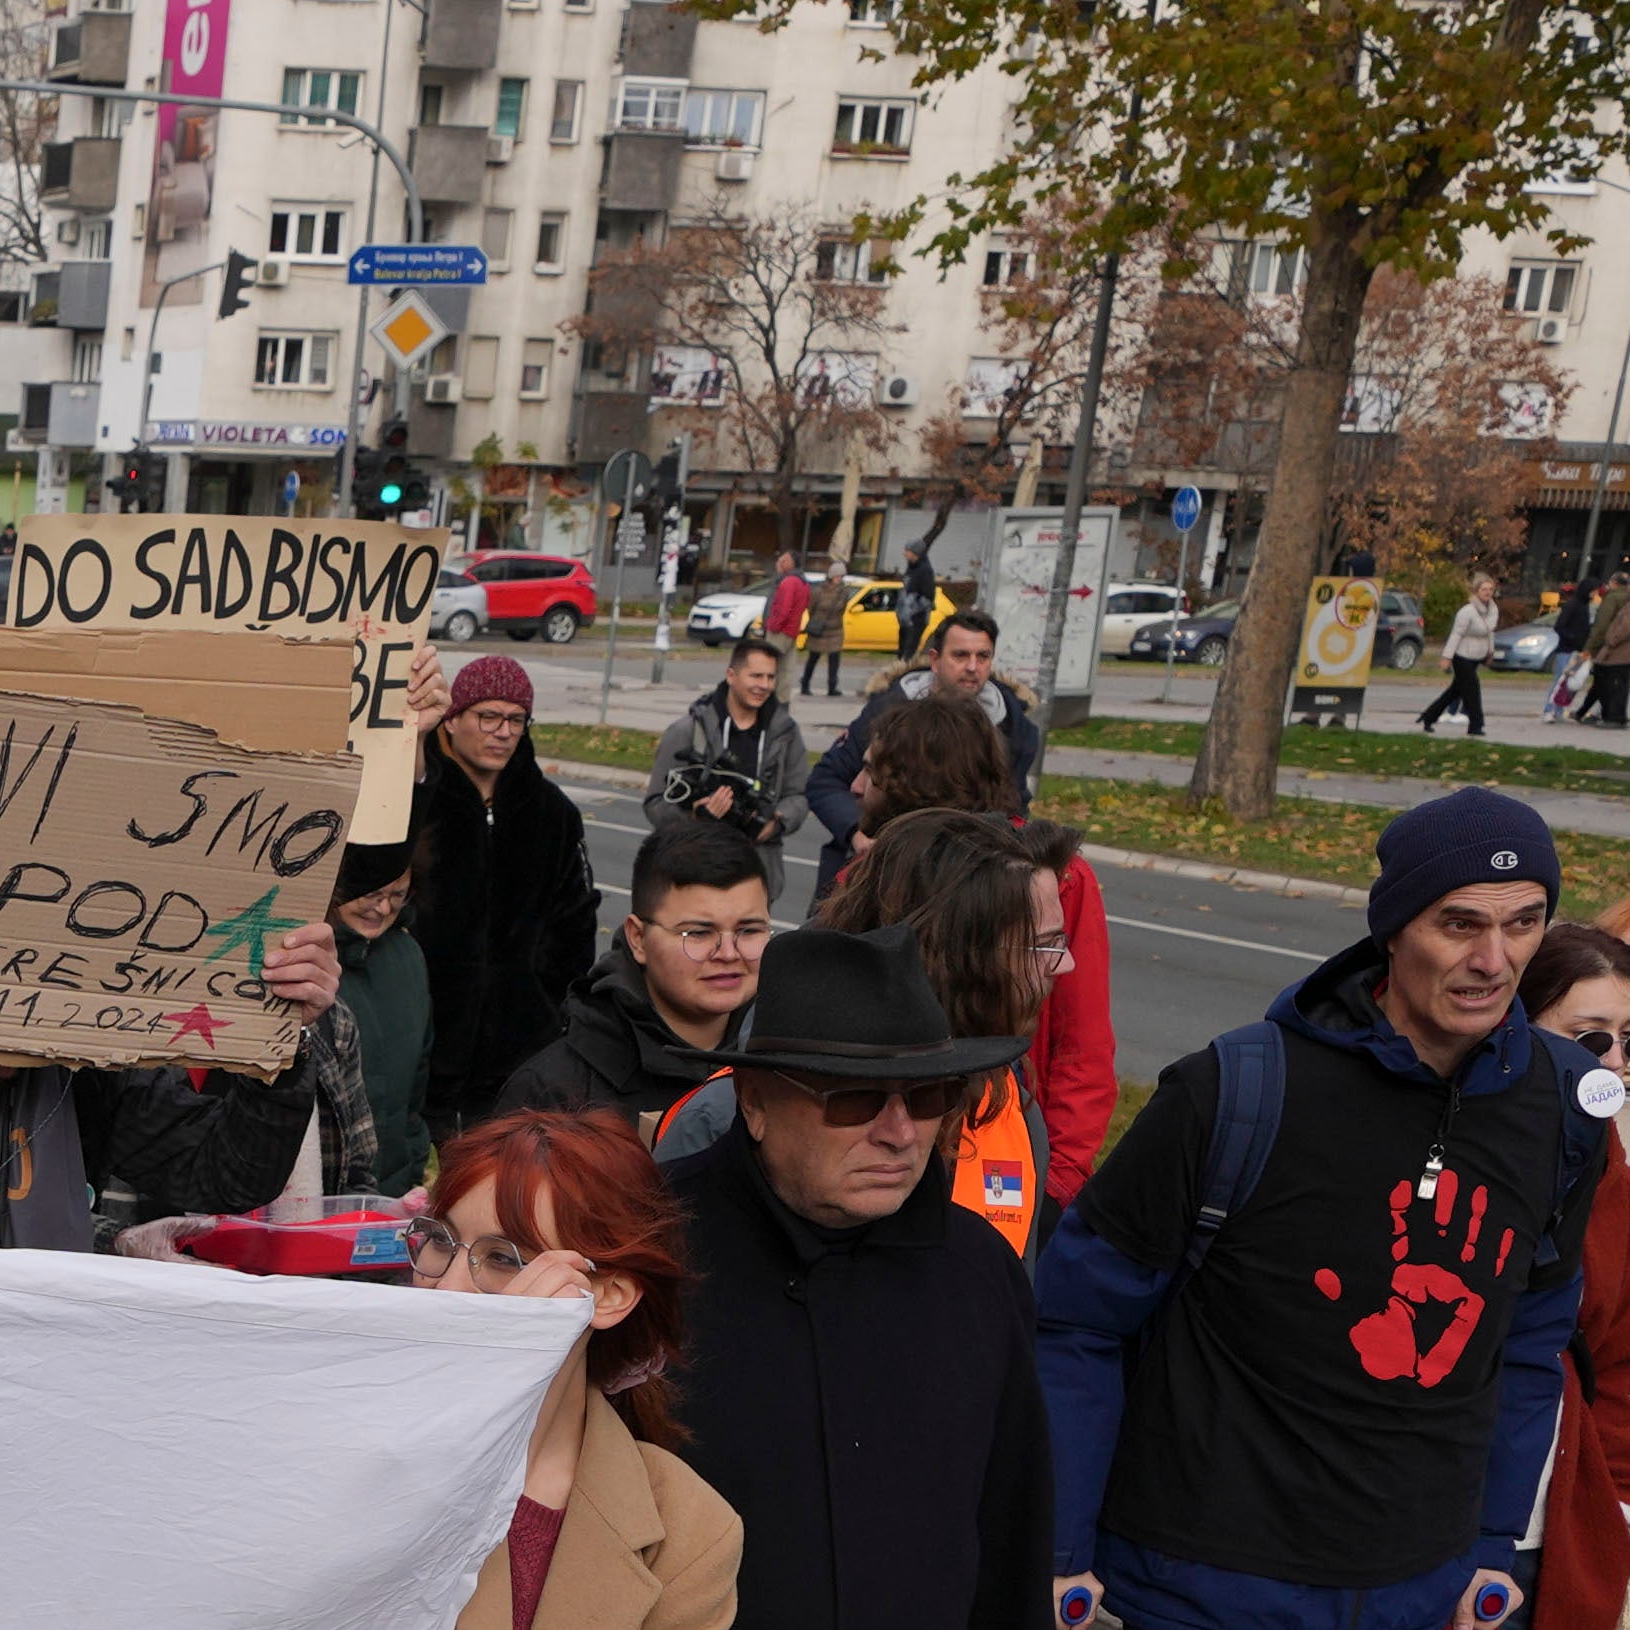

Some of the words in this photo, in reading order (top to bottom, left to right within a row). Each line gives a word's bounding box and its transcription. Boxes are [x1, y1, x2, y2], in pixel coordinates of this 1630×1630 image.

[202, 426, 289, 443] VIOLETA
[15, 538, 112, 627] DO
[127, 771, 344, 878] SMO
